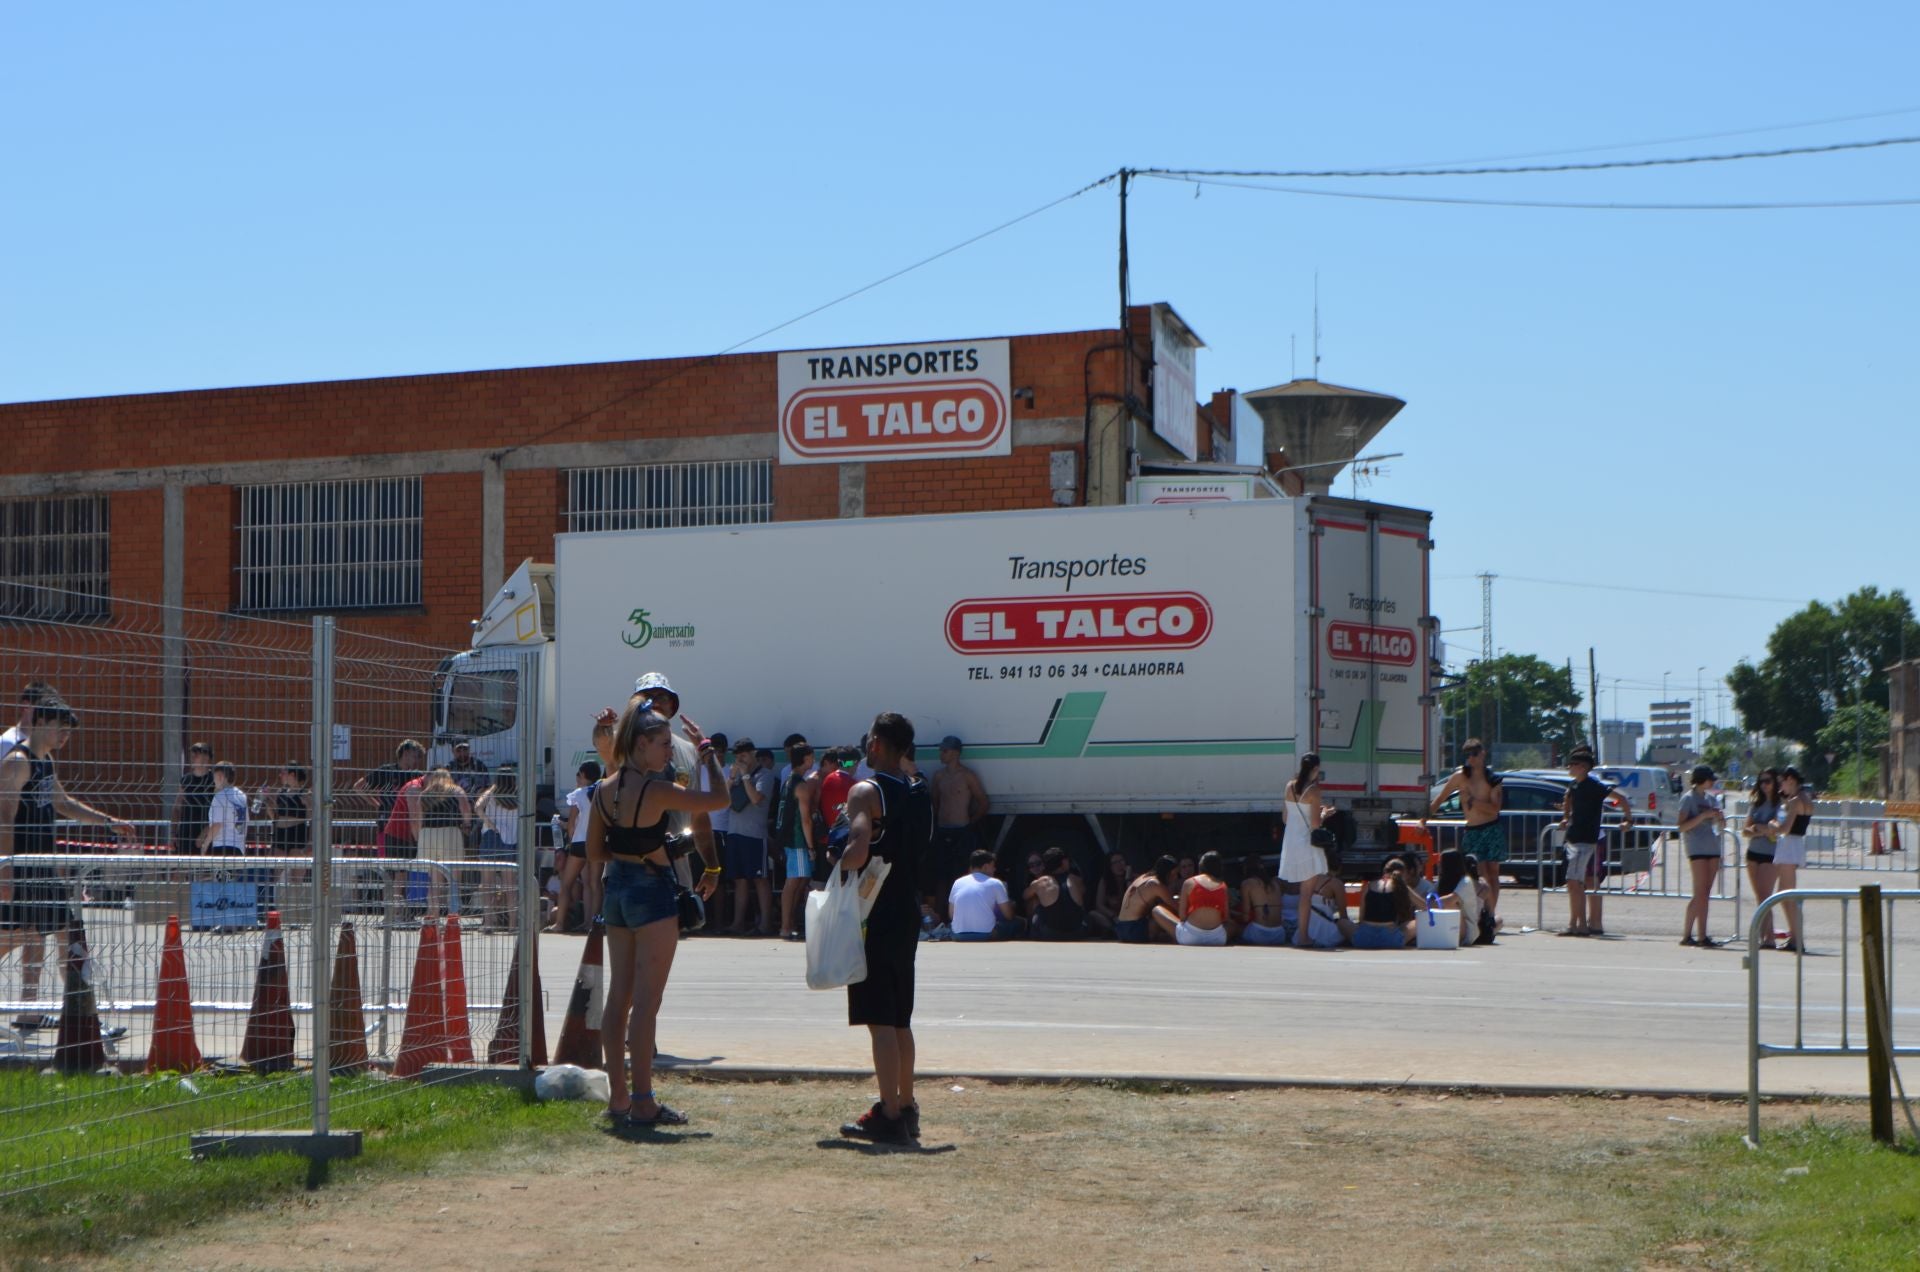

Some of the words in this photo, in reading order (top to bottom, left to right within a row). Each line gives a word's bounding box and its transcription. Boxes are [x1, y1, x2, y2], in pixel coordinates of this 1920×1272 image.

[808, 348, 978, 380] TRANSPORTES
[803, 406, 847, 440] EL
[862, 398, 985, 437] TALGO
[1008, 553, 1146, 592] Transportes
[653, 622, 695, 639] aniversario
[961, 611, 1016, 642] EL
[1036, 605, 1194, 639] TALGO
[1332, 630, 1351, 650] EL
[1358, 633, 1411, 657] TALGO
[968, 666, 993, 680] TEL.
[1000, 666, 1022, 679] 941
[1028, 665, 1042, 678] 13
[1048, 665, 1065, 678] 06
[1071, 664, 1088, 677] 34
[1102, 662, 1184, 676] CALAHORRA
